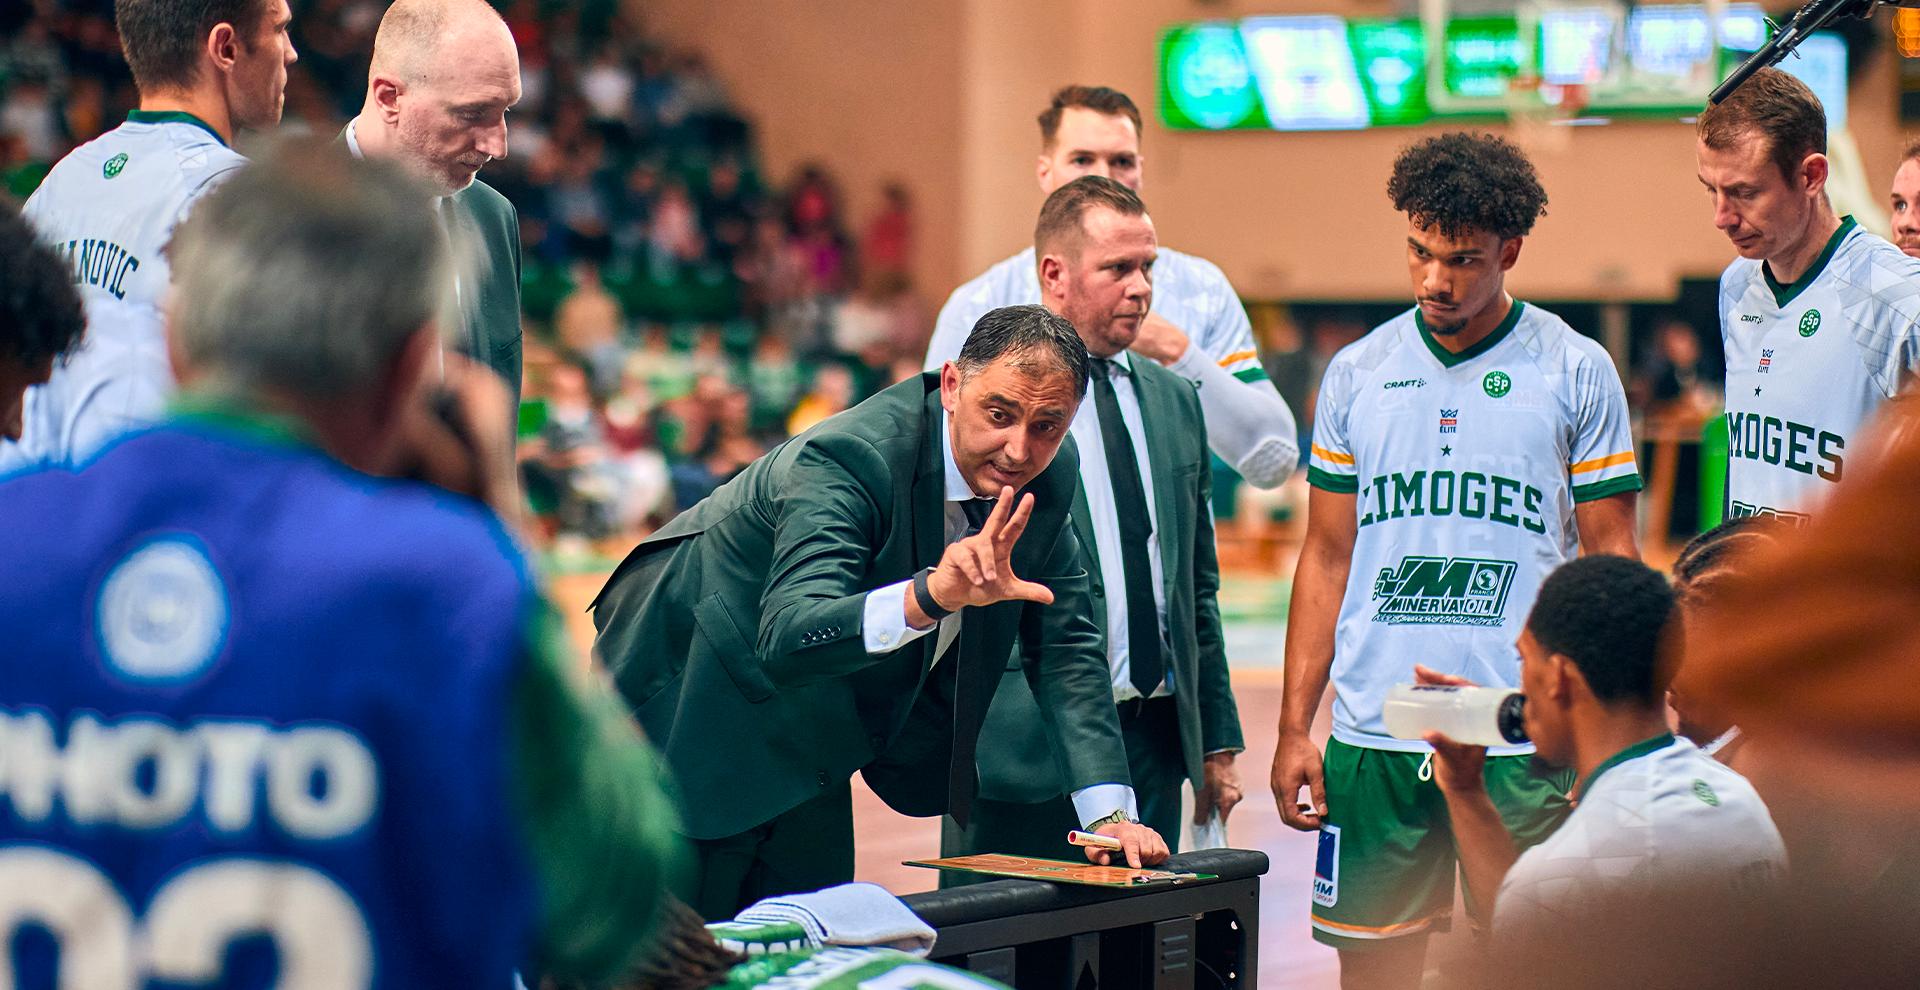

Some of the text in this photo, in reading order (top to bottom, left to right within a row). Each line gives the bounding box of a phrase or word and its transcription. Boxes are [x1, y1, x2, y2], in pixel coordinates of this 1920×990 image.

[1801, 314, 1819, 329] CSP
[1384, 379, 1417, 389] CRAFT
[1486, 375, 1509, 390] CSP
[1384, 597, 1493, 615] MINERVA OIL
